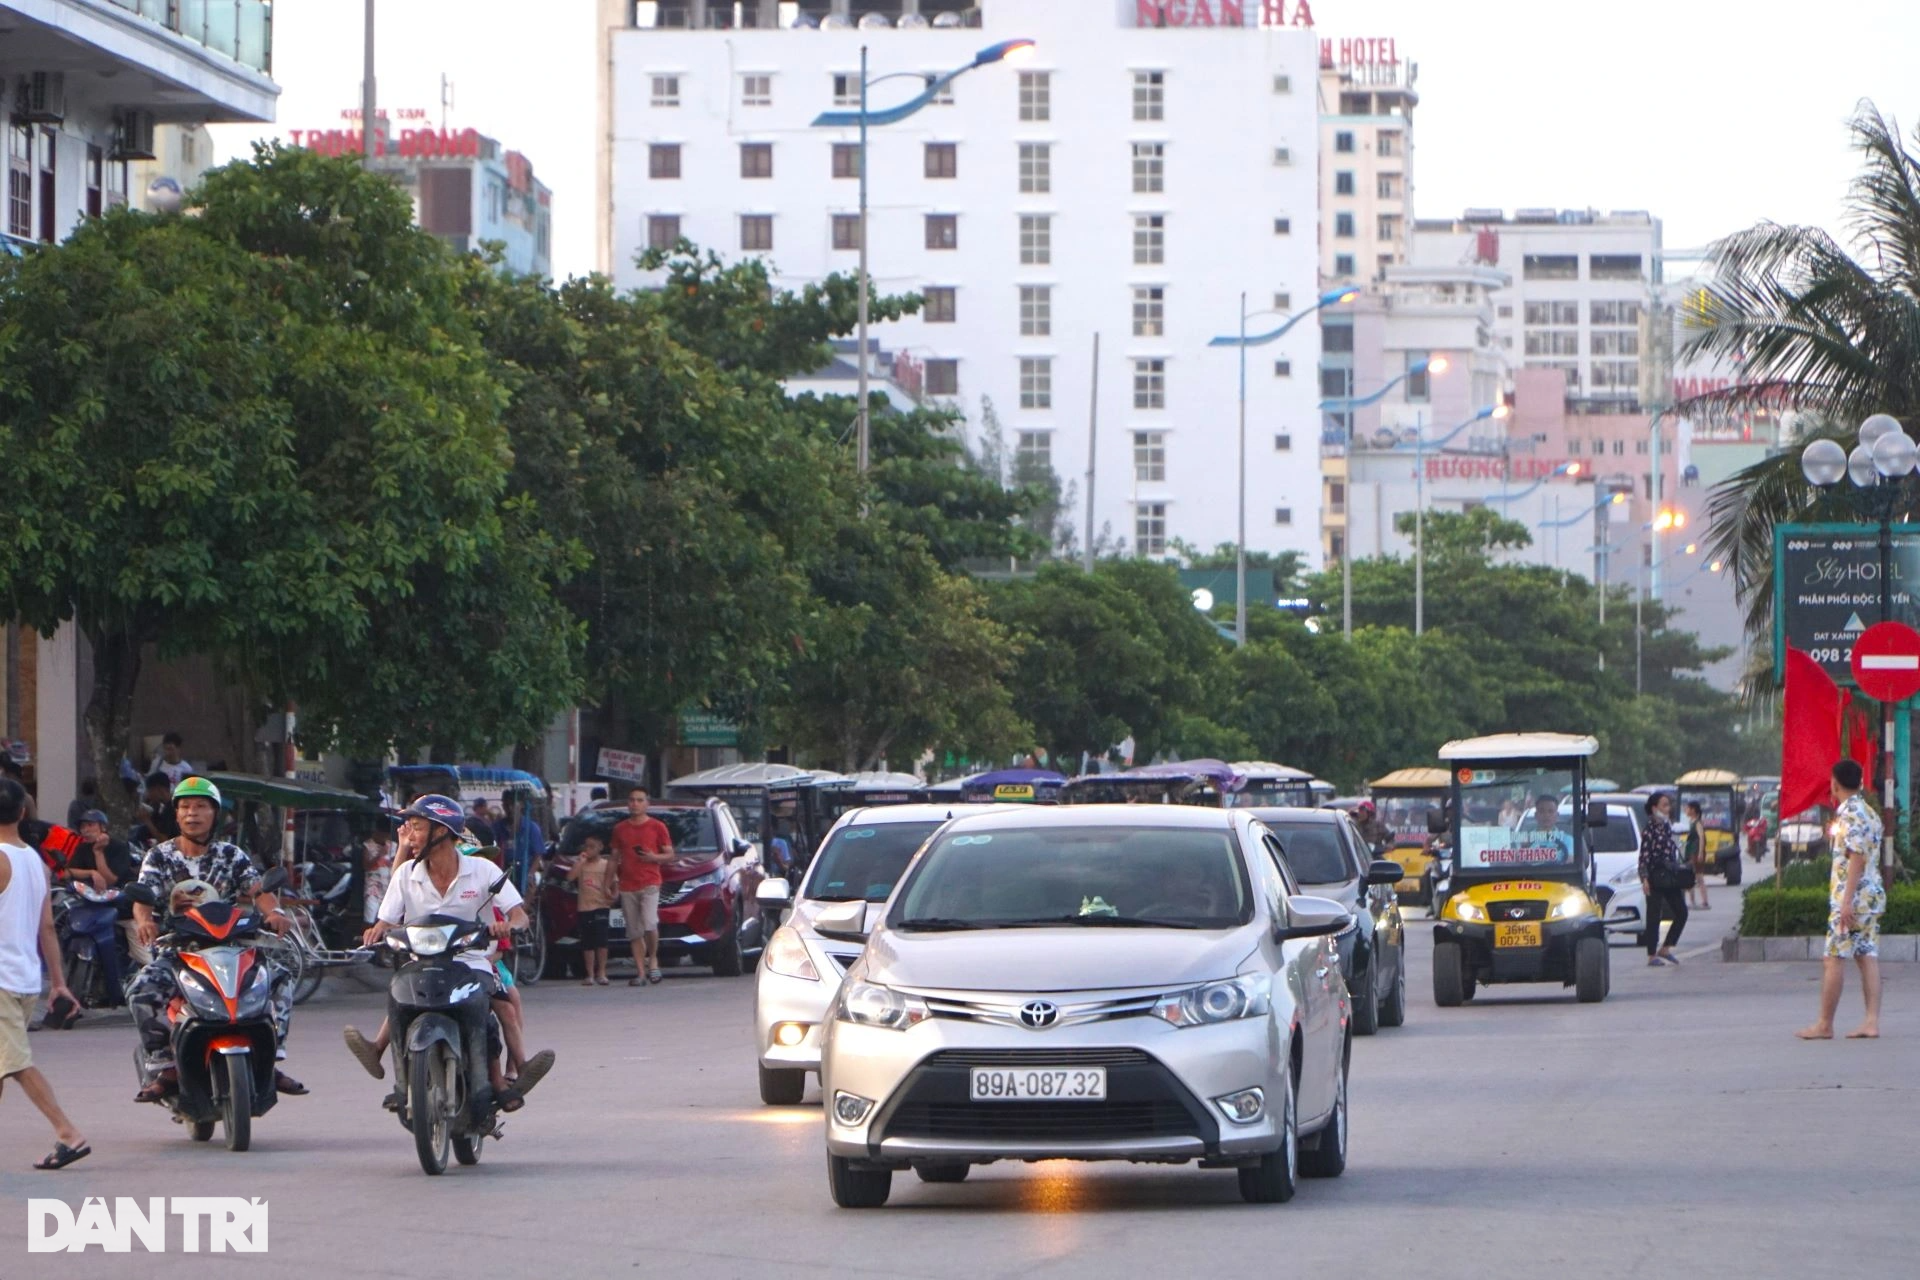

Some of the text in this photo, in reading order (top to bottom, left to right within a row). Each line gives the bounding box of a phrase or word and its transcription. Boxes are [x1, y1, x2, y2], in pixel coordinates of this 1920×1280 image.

[1340, 37, 1401, 66] HOTEL
[1848, 562, 1903, 580] HOTL
[1832, 632, 1855, 641] XANH
[1811, 648, 1840, 663] 098
[976, 1072, 1101, 1097] 89A-087.32
